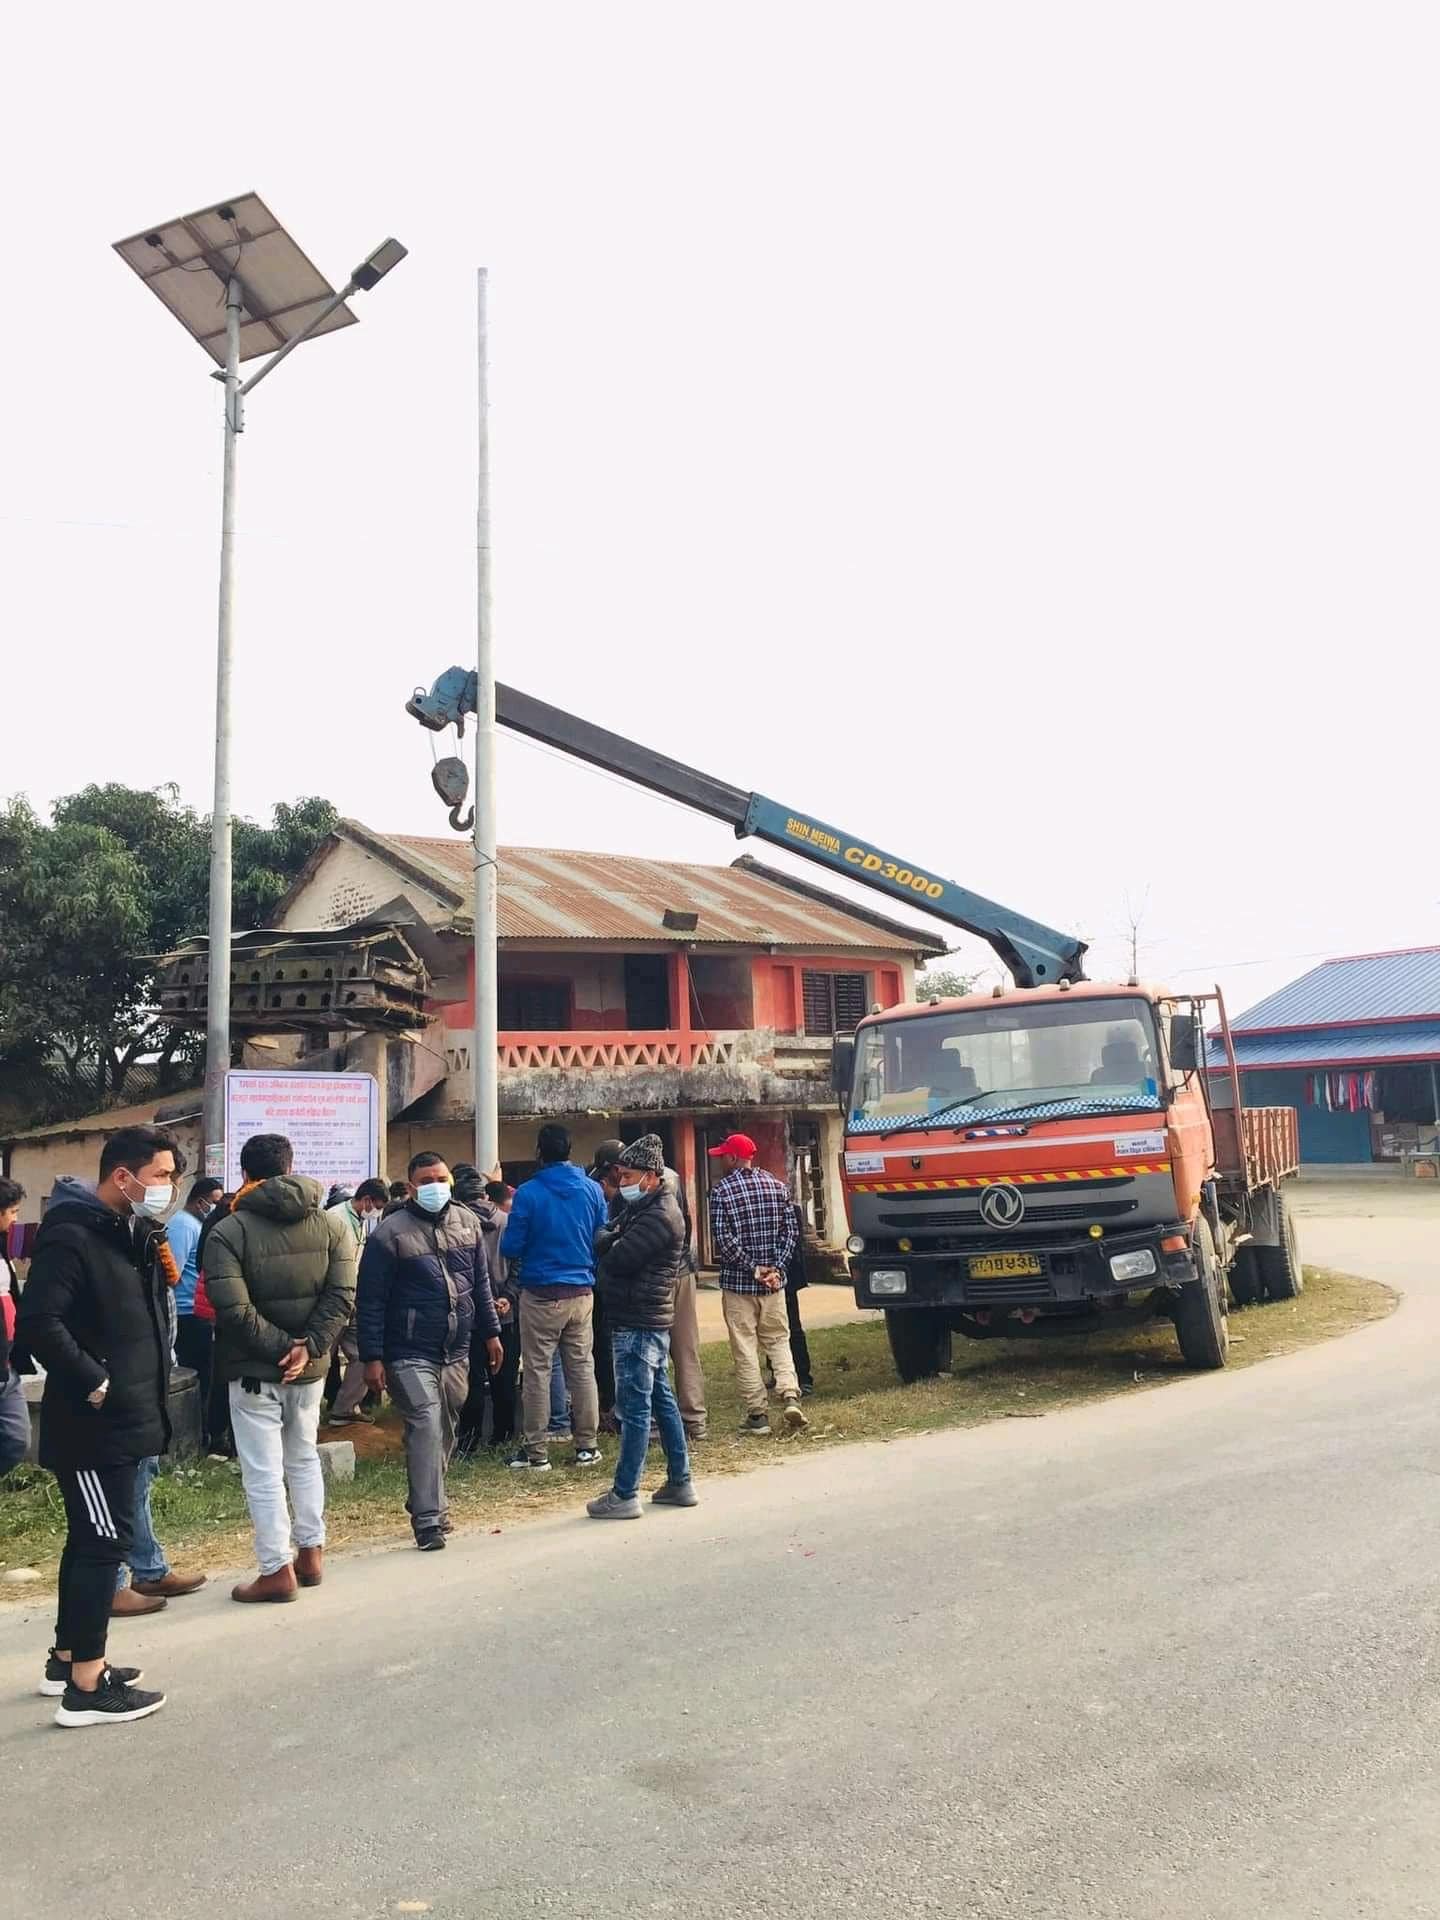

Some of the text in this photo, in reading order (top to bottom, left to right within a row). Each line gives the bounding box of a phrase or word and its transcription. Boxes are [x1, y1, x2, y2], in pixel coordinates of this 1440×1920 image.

[786, 817, 810, 837] SHIN
[810, 828, 840, 850] MEIWA
[843, 847, 944, 898] CD3000
